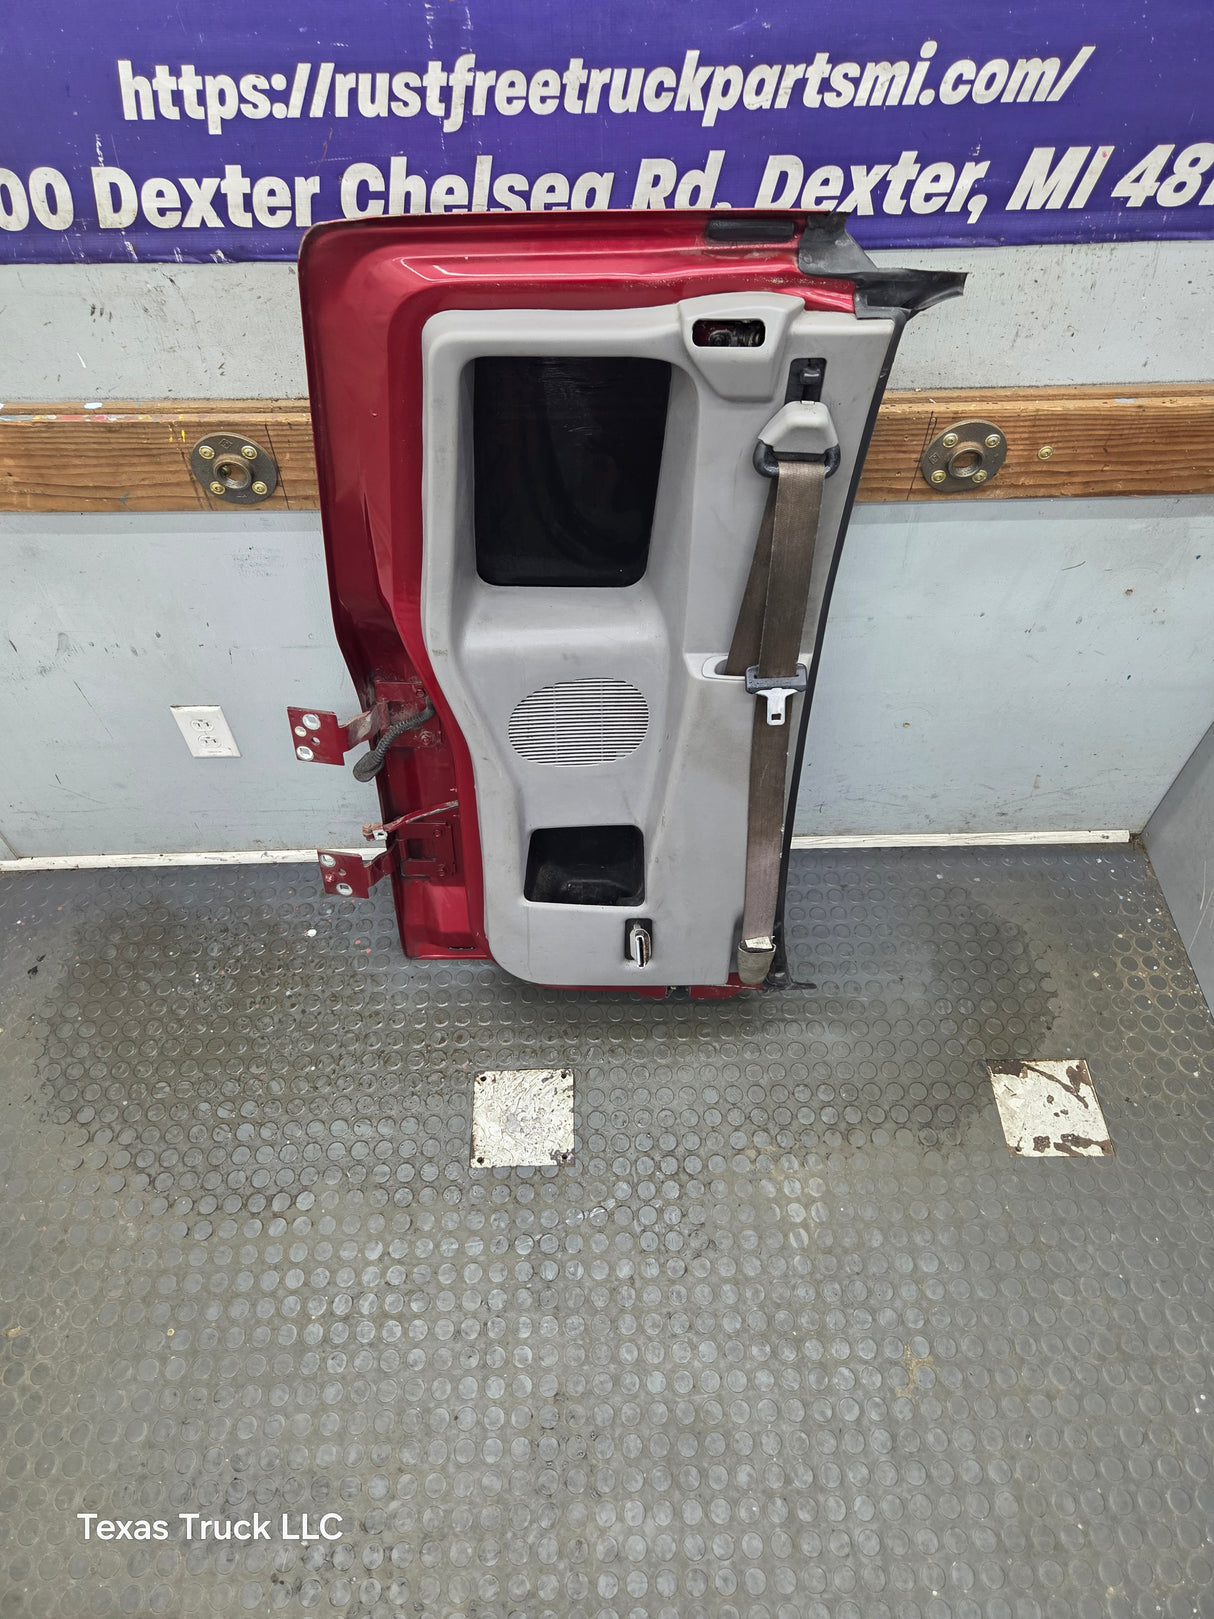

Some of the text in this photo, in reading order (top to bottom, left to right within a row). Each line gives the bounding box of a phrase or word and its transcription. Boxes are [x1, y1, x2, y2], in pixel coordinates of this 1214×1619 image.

[117, 40, 1096, 135] https://rustfreetruckpartsmi.com/
[91, 164, 321, 229] Dexter
[341, 154, 615, 220] Chelsea
[755, 151, 991, 224] Dexter,
[1005, 146, 1115, 211] MI
[1111, 142, 1214, 207] 48
